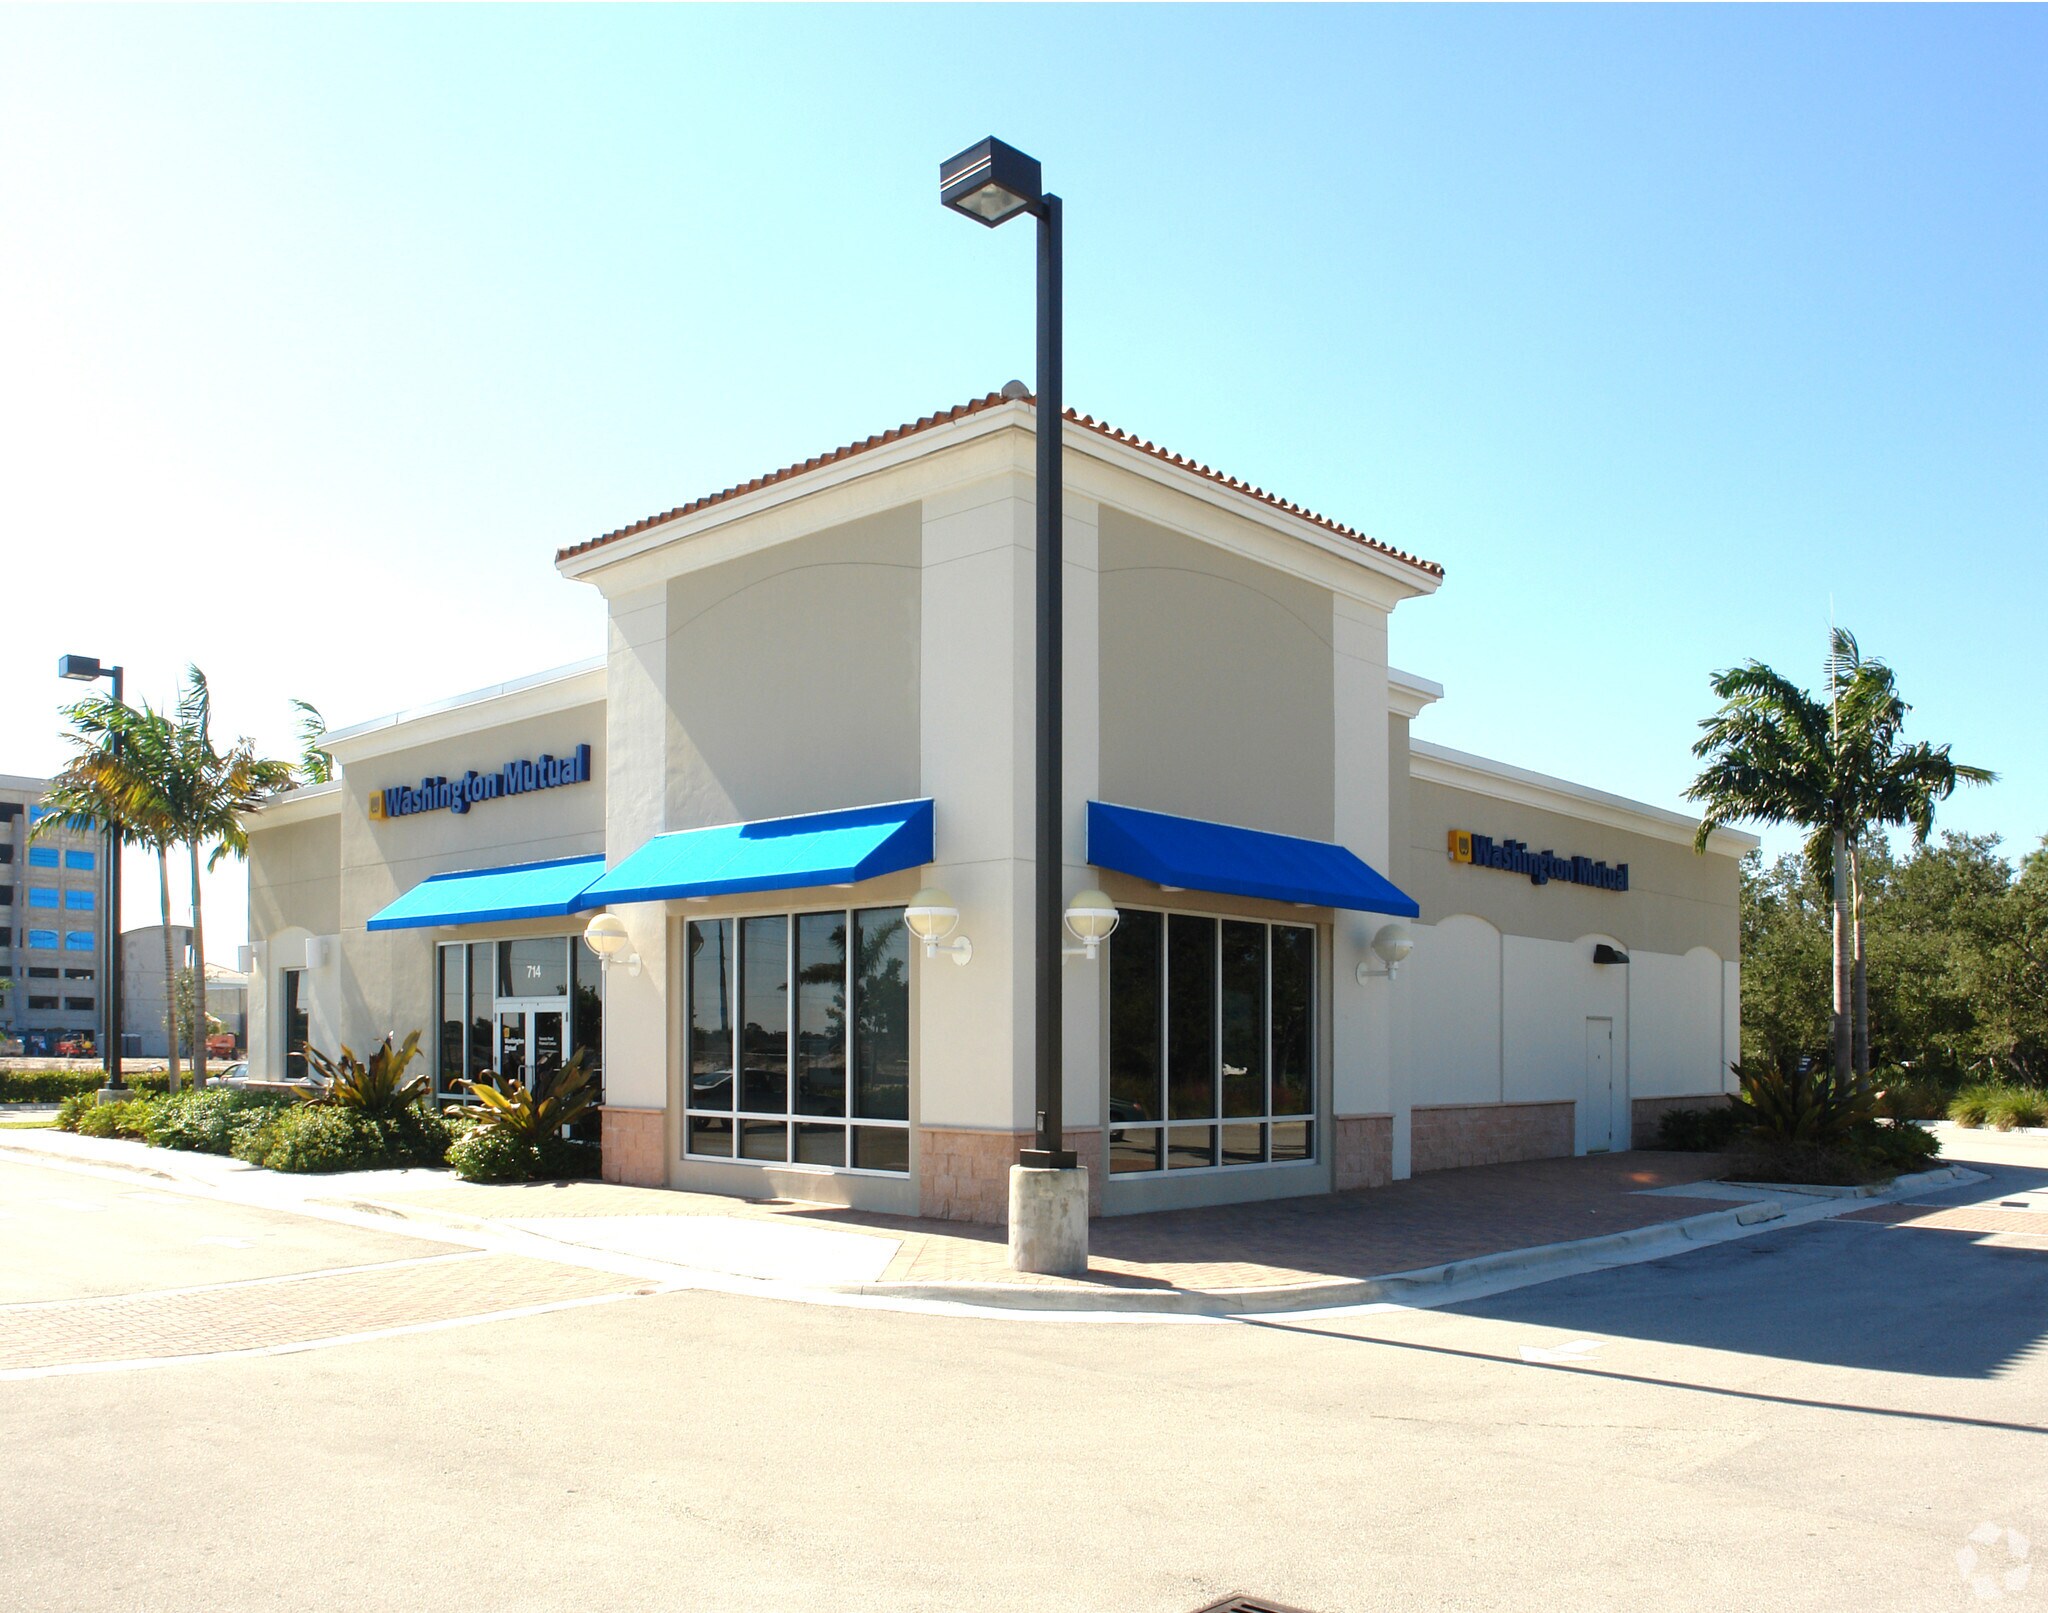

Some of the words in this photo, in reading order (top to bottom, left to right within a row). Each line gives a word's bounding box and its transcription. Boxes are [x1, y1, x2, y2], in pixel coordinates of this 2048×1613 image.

[385, 770, 502, 817] Washington
[503, 744, 590, 797] Mutual
[1471, 833, 1573, 885] Washington
[1571, 856, 1629, 891] Mutual
[526, 965, 541, 979] 714
